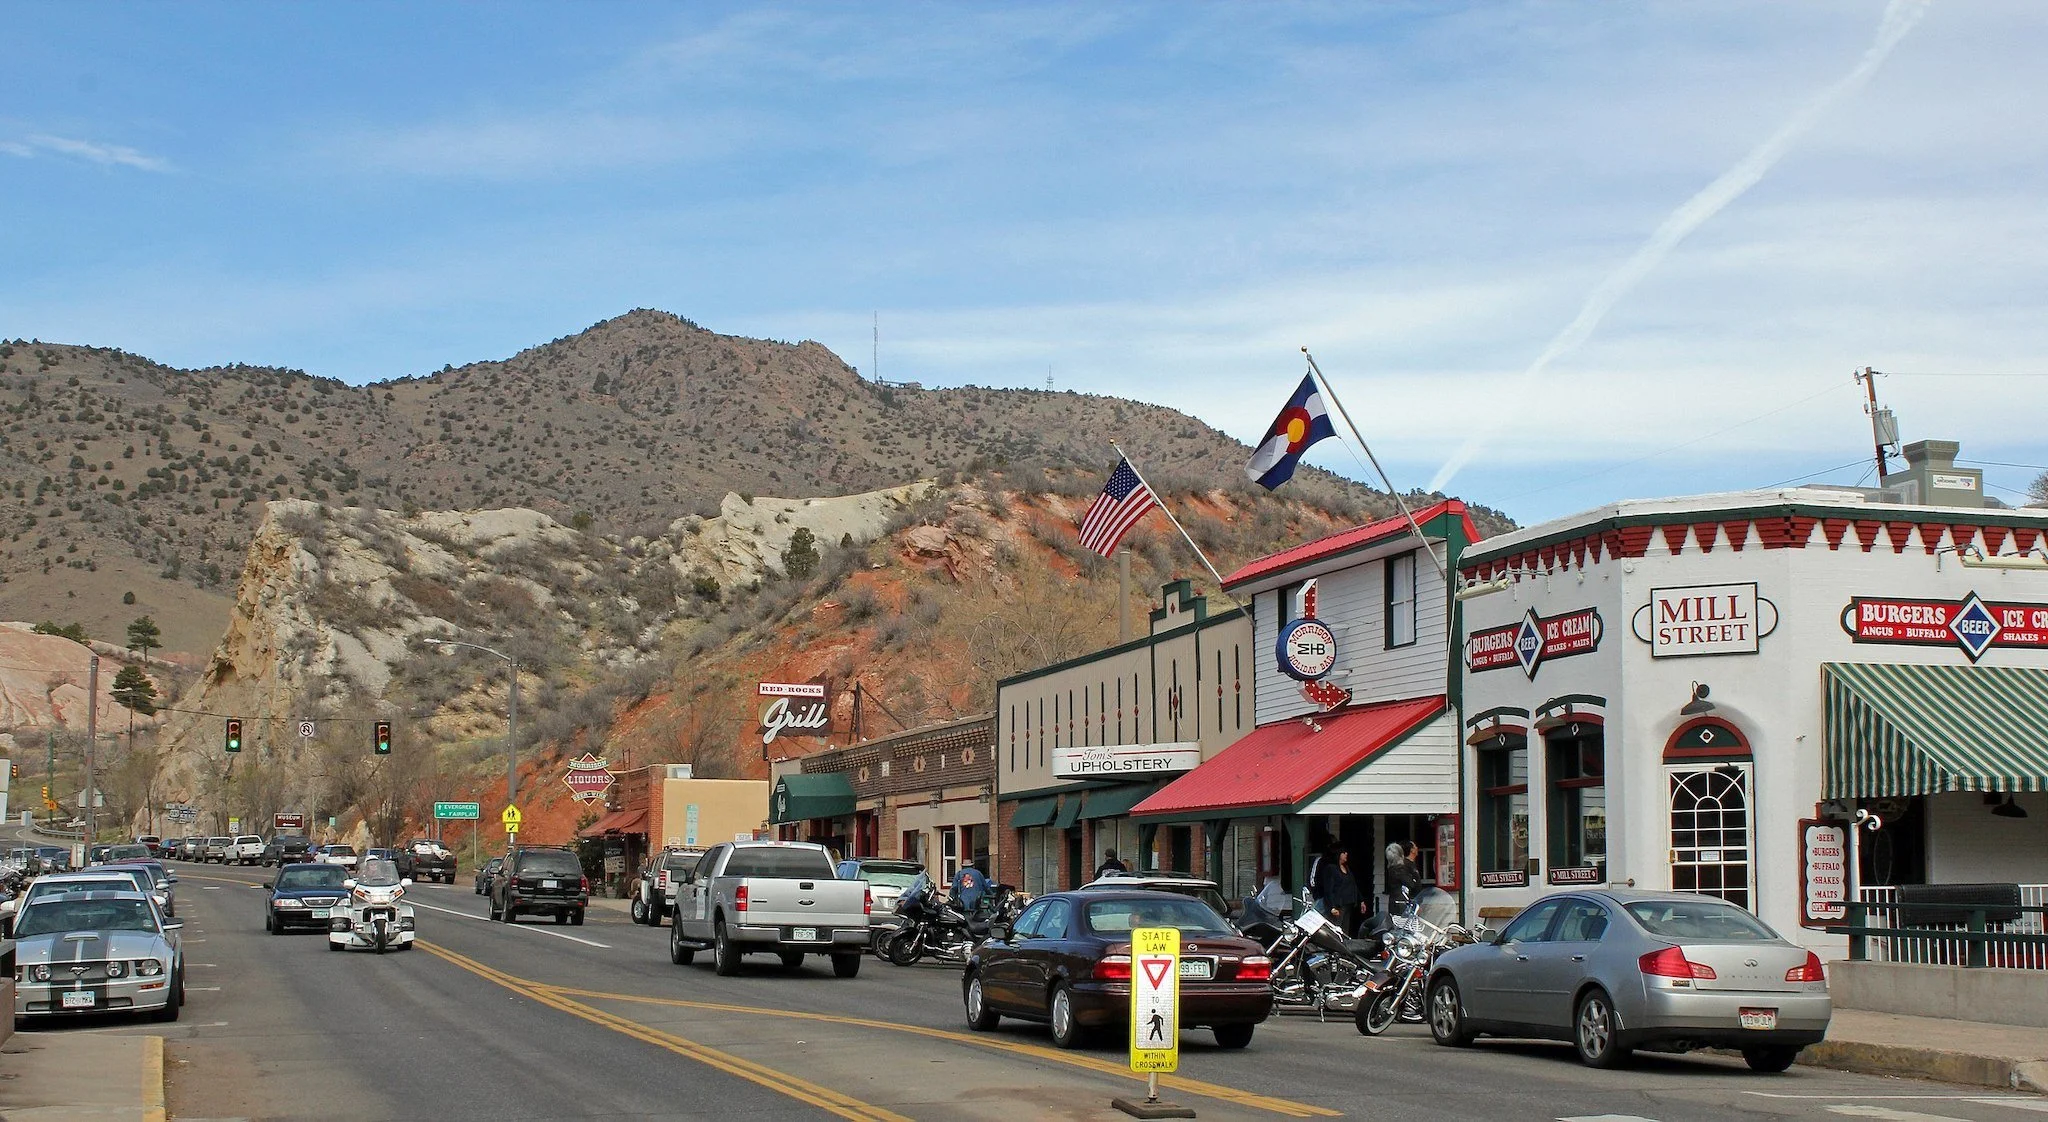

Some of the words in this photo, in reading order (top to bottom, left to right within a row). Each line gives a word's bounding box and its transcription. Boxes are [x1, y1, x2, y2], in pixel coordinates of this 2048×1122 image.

[1658, 595, 1748, 624] MILL
[1861, 603, 1946, 625] BURGERS
[2002, 609, 2025, 628] ICE
[1546, 622, 1559, 640] ICE
[1562, 615, 1590, 637] CREAM
[1861, 626, 1894, 636] ANGUS
[1906, 628, 1947, 639] BUFFALO
[1961, 619, 1990, 635] BEER
[1289, 625, 1333, 645] MORRISON
[1659, 623, 1749, 645] STREET
[2003, 632, 2039, 642] SHAKES
[1472, 631, 1513, 654] BURGERS
[1520, 636, 1536, 651] BEER
[1547, 642, 1567, 653] SHAKES
[1572, 638, 1590, 648] MALTS
[1288, 655, 1317, 674] HOLIDAY
[1319, 655, 1334, 671] BAR
[1472, 656, 1488, 666] ANGUS
[1492, 651, 1514, 663] BUFFALO
[763, 697, 828, 744] Grill
[1082, 748, 1114, 760] Tom's
[569, 760, 608, 769] MORRISON
[1070, 758, 1173, 773] UPHOLSTERY
[568, 775, 611, 784] LIQUORS
[1818, 834, 1835, 842] BEER
[1814, 847, 1840, 856] BURGERS
[1814, 862, 1840, 871] BUFFALO
[1486, 875, 1499, 883] MILL
[1500, 873, 1518, 882] STREET
[1557, 871, 1571, 880] MILL
[1571, 870, 1592, 879] STREET
[1812, 902, 1826, 911] OPEN
[1142, 931, 1172, 941] STATE
[1146, 943, 1167, 952] LAW
[1151, 996, 1160, 1004] TO
[1134, 1059, 1174, 1069] CROSSWALK
